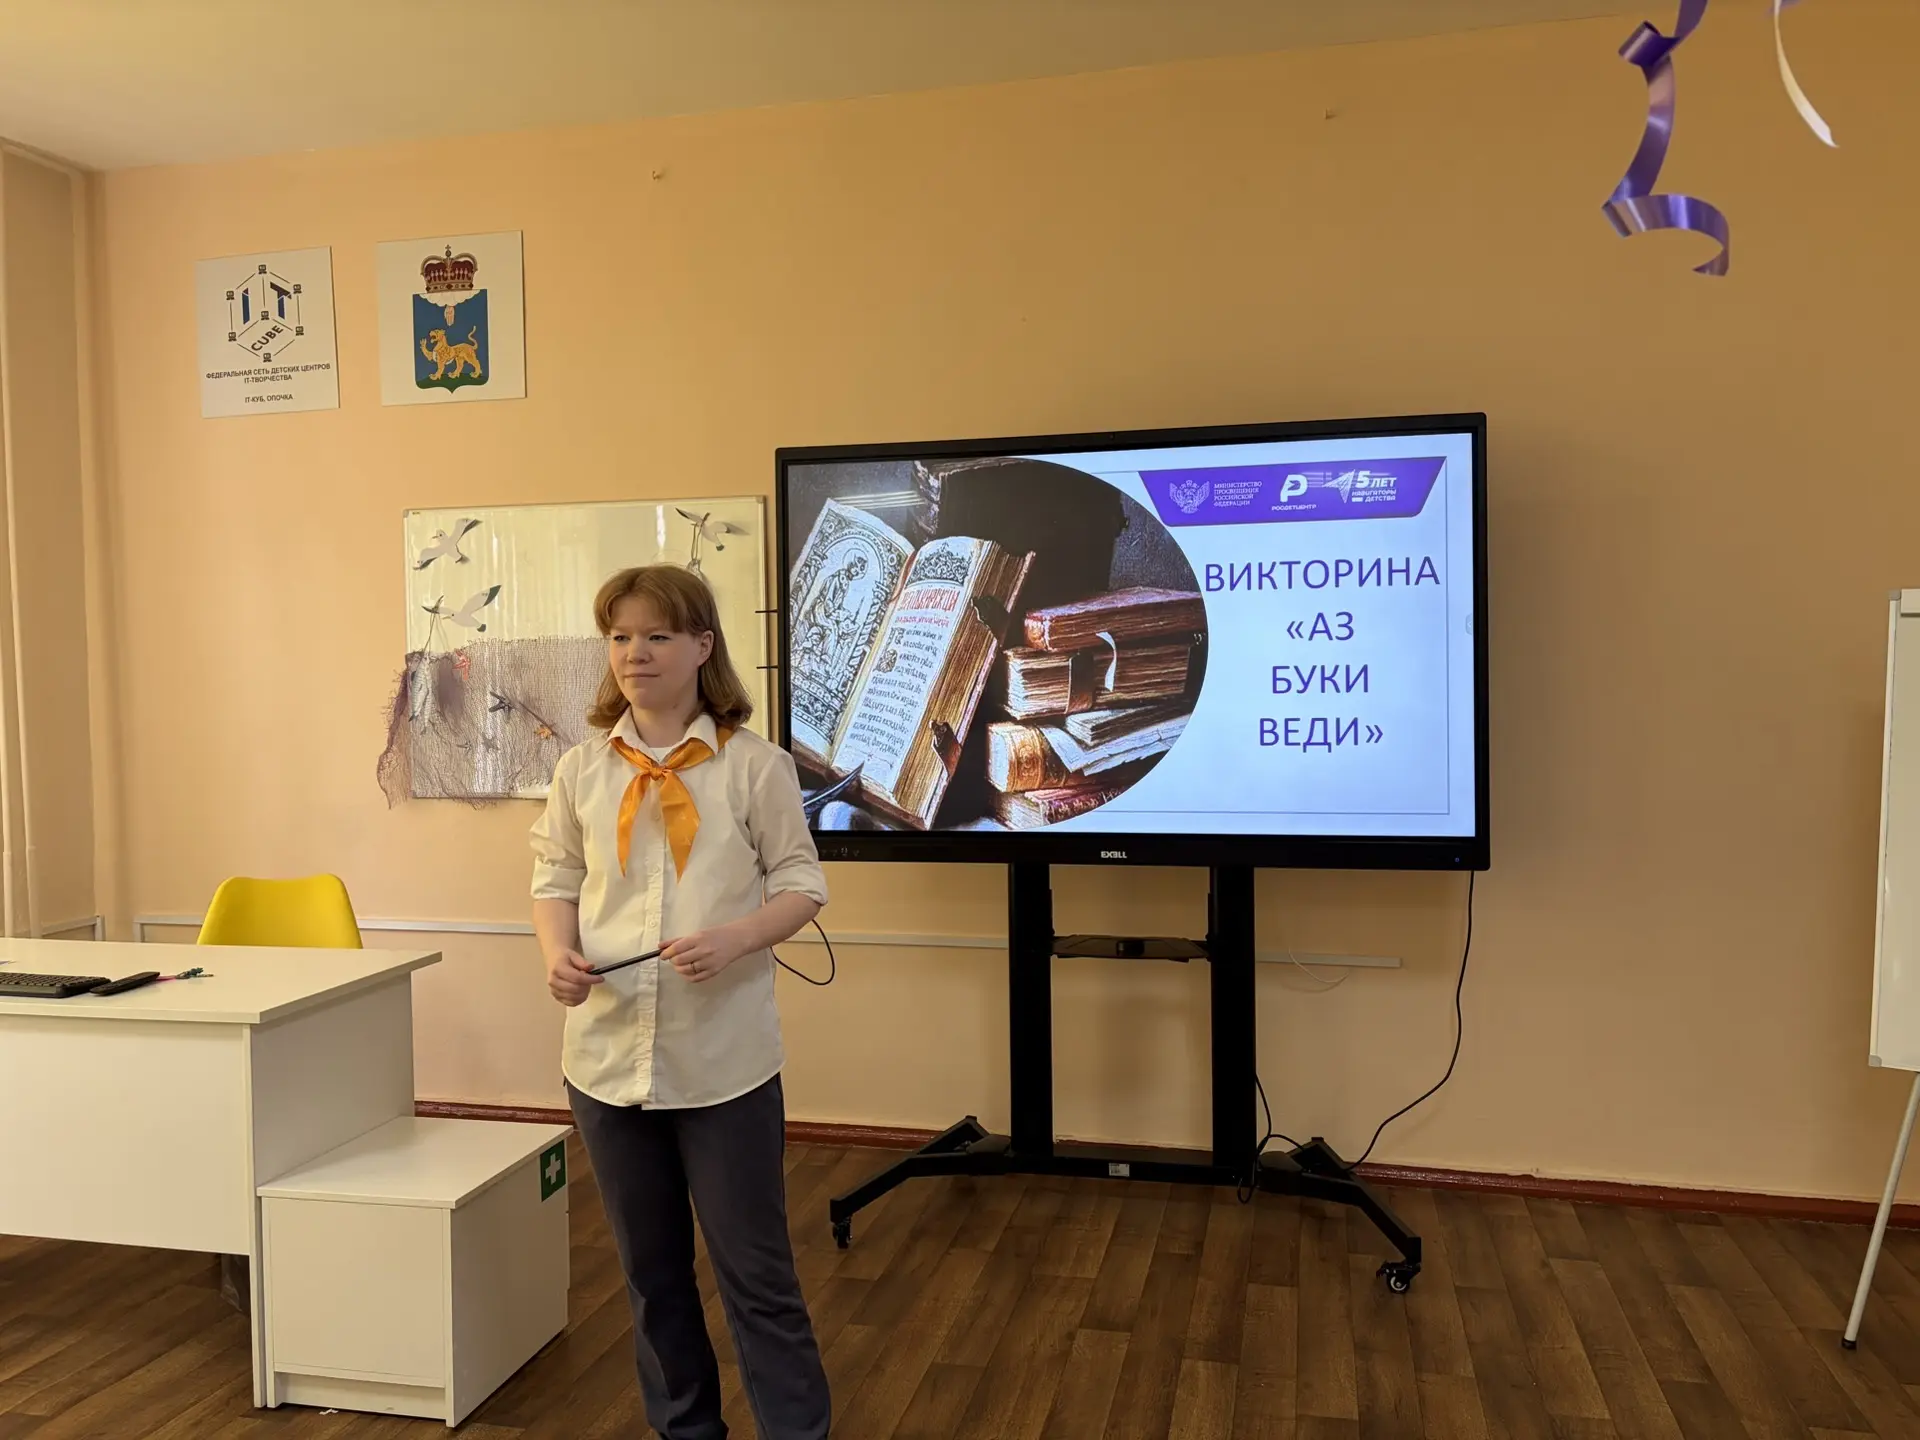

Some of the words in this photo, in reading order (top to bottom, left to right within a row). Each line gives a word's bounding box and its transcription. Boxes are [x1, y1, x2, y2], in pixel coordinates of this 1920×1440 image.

[251, 325, 284, 351] CUBE
[206, 369, 252, 379] ФЕДЕРАЛЬНАЯ
[253, 367, 270, 376] СЕТЬ
[271, 365, 300, 374] ДЕТСКИХ
[301, 363, 331, 372] ЦЕНТРОВ
[244, 374, 293, 384] IT-ТВОРЧЕСТВА
[266, 394, 293, 402] ОПОЧКА
[1213, 481, 1262, 489] МИНИСТЕРСТВО
[1355, 470, 1370, 488] 5
[1370, 477, 1397, 488] ЛЕТ
[1213, 487, 1259, 495] ПРОСВЕЩЕНИЯ
[1364, 495, 1396, 503] ДЕТСТВА
[1205, 556, 1440, 592] ВИКТОРИНА
[1286, 611, 1354, 641] «АЗ
[1272, 664, 1369, 694] БУКИ
[1259, 717, 1384, 753] ВЕДИ»
